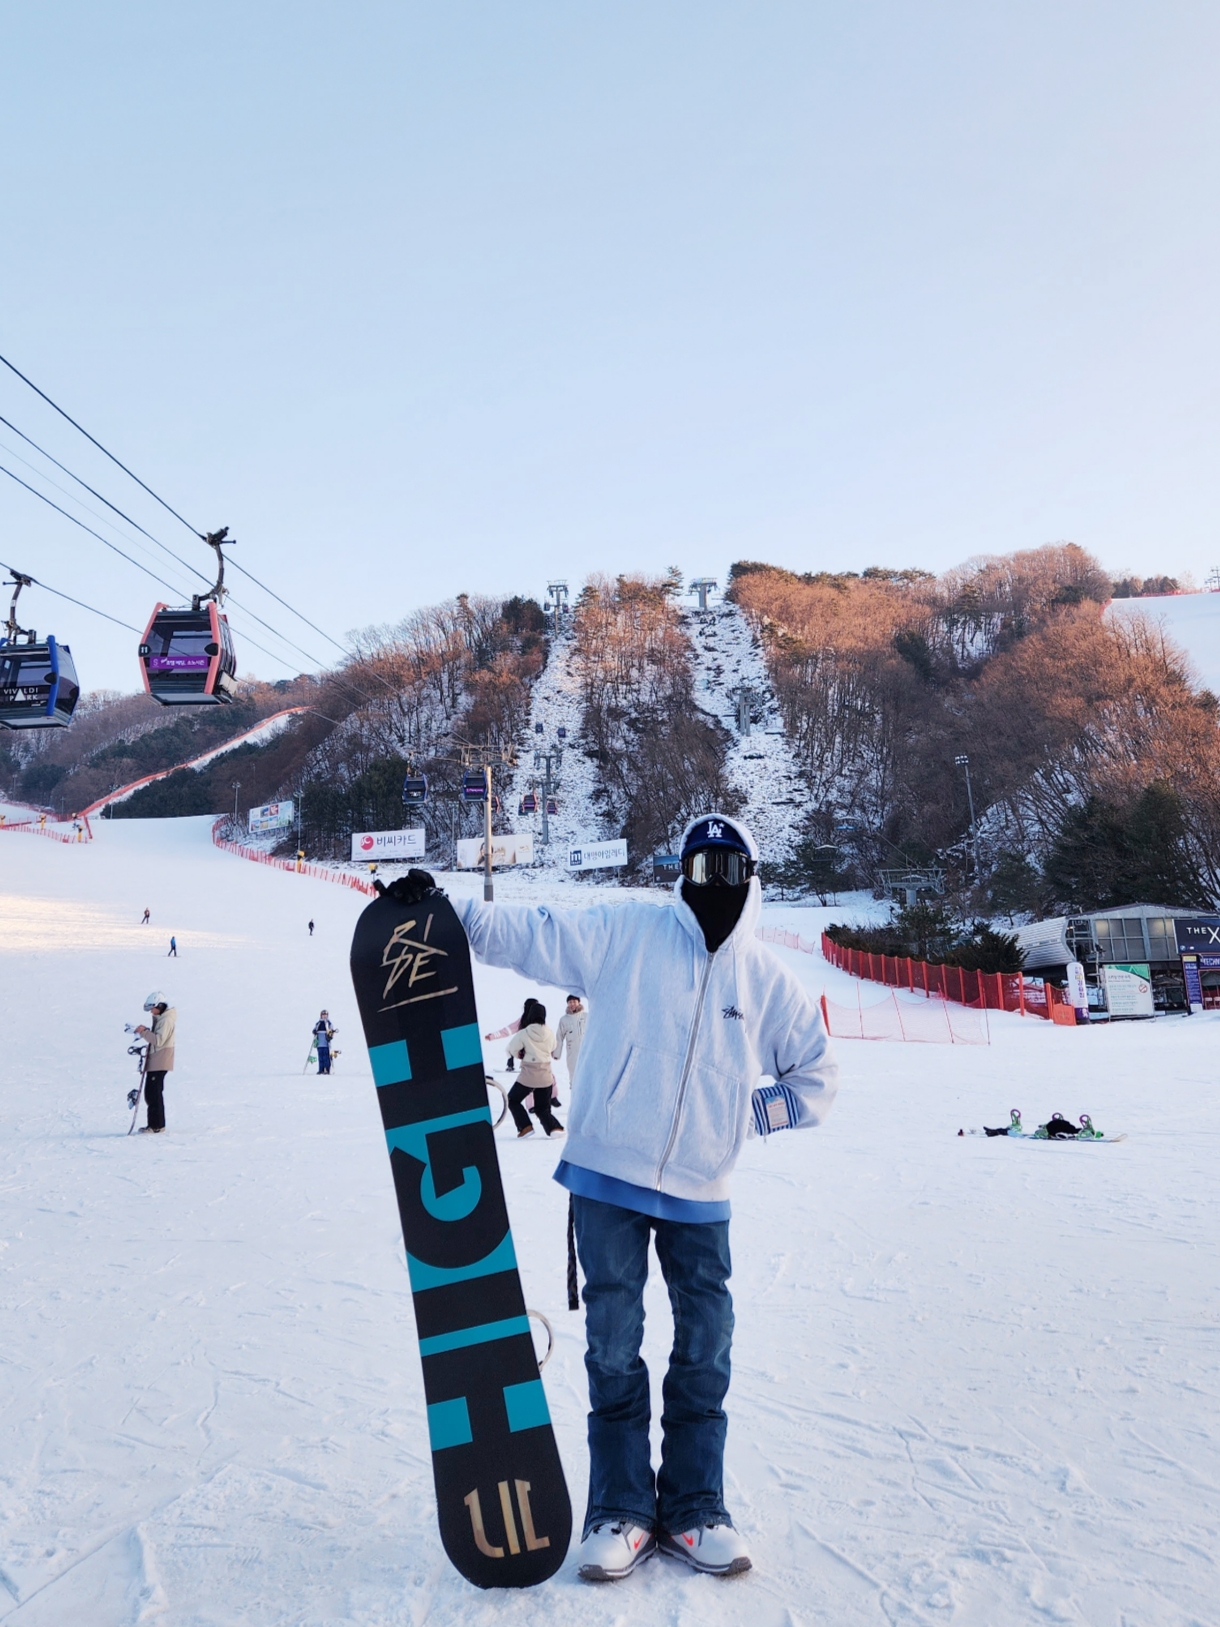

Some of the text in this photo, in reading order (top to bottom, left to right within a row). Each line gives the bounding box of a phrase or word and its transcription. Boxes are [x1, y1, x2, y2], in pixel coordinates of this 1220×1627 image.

[707, 821, 725, 838] LA
[376, 834, 417, 847] 비씨카드
[1186, 926, 1207, 935] THE
